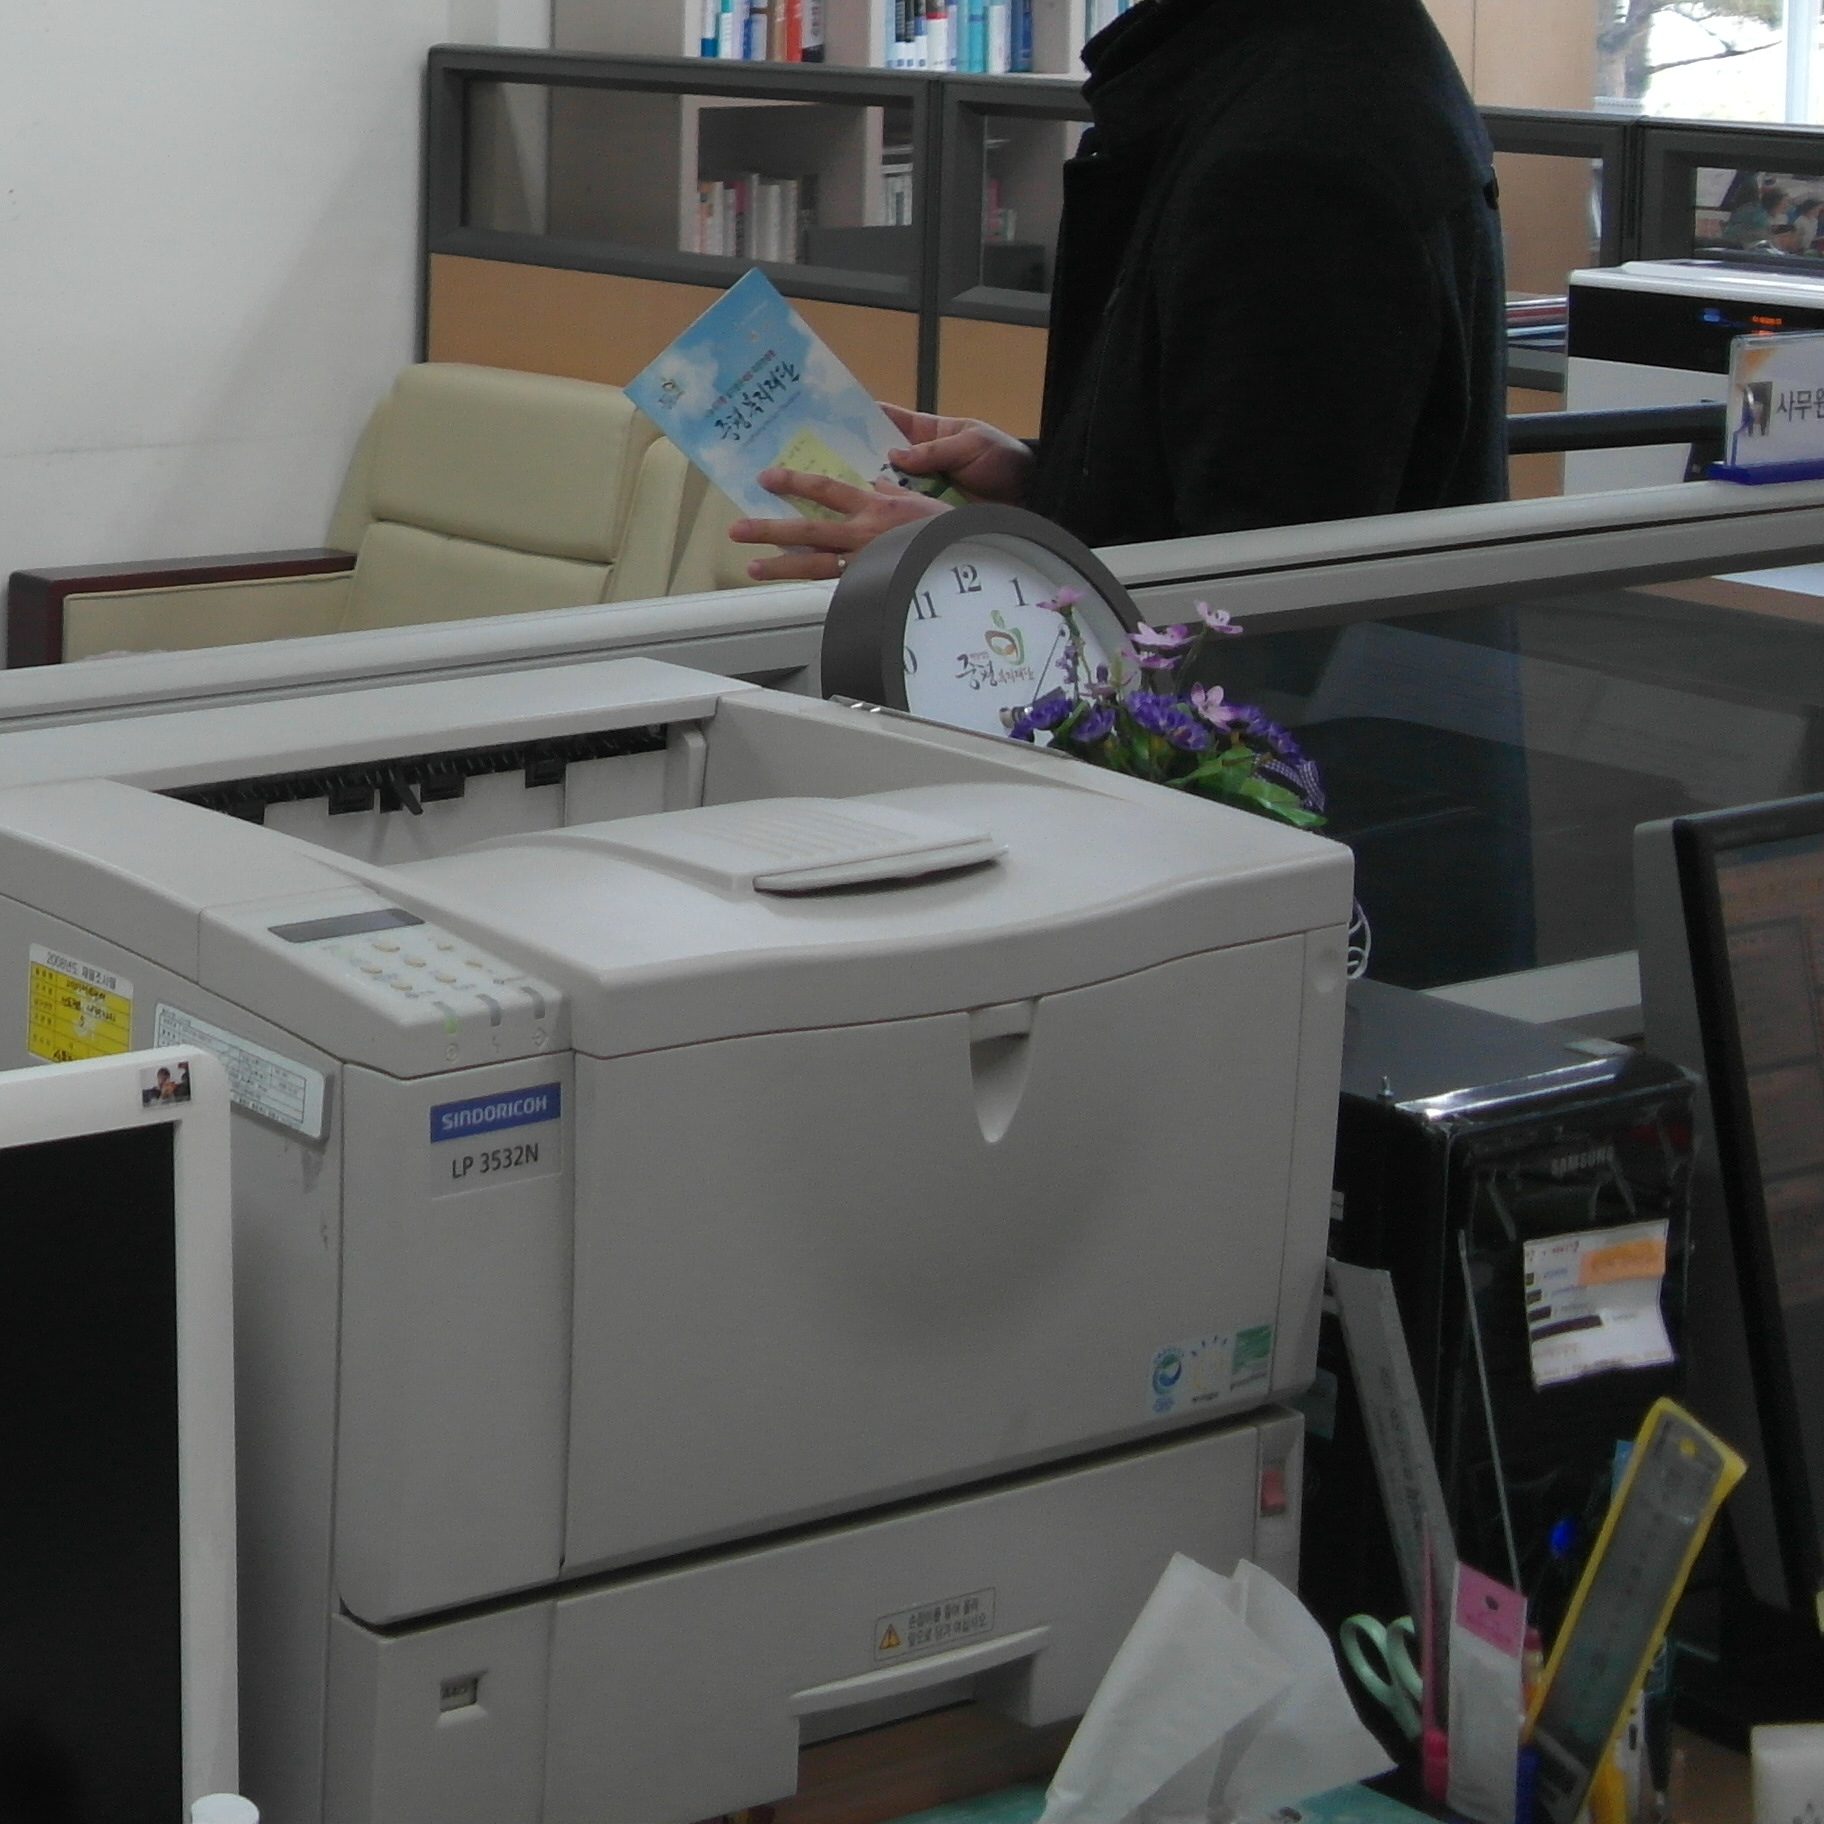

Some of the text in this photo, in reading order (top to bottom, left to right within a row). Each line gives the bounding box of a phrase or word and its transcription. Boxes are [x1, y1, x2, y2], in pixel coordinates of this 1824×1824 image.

[952, 564, 982, 593] 12
[1011, 577, 1029, 606] 1
[914, 590, 942, 620] 11
[442, 1095, 548, 1131] SINDORICOH
[453, 1143, 539, 1179] LP 3532N
